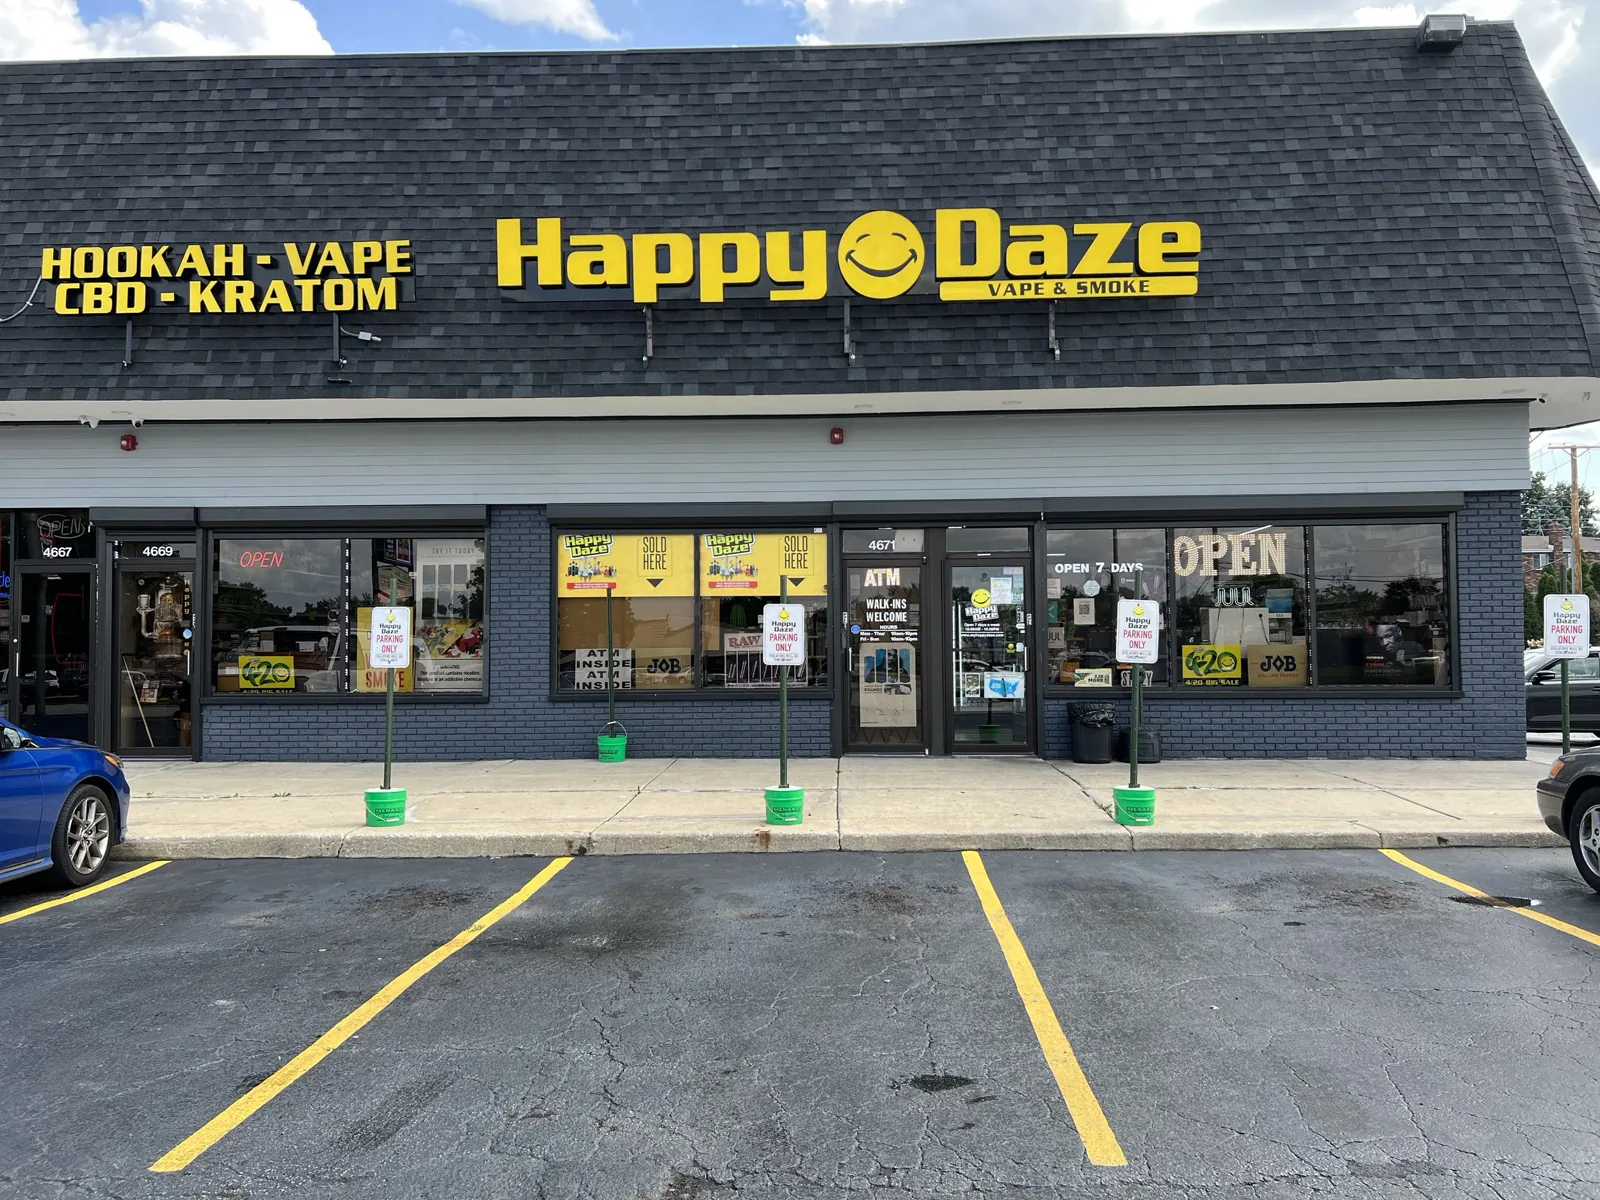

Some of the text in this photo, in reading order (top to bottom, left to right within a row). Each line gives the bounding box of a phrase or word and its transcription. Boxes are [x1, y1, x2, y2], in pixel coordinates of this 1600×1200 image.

[41, 243, 245, 280] HOOKAH
[284, 240, 411, 276] VAPE
[497, 208, 1201, 302] Happy Daze
[987, 279, 1150, 297] VAPE & SMOKE
[54, 281, 146, 315] CBD
[189, 277, 397, 314] KRATOM
[40, 518, 82, 538] OPEN
[565, 534, 612, 547] Happy
[643, 536, 667, 553] SOLD
[707, 533, 754, 546] Happy
[784, 535, 808, 552] SOLD
[868, 540, 895, 550] 4671
[43, 547, 72, 557] 4667
[142, 546, 173, 557] 4669
[572, 545, 608, 556] Daze
[714, 544, 749, 555] Daze
[1173, 533, 1287, 576] OPEN
[240, 551, 284, 568] OPEN
[643, 554, 667, 570] HERE
[784, 553, 808, 569] HERE
[1055, 562, 1144, 573] OPEN 7 DAYS
[864, 567, 901, 587] ATM
[1215, 587, 1254, 606] JUUL
[866, 598, 907, 609] WALK-INS
[965, 605, 997, 616] Happy
[866, 611, 908, 622] WELCOME
[973, 612, 999, 622] Daze
[1125, 617, 1151, 625] Happy
[1123, 630, 1153, 639] PARKING
[1551, 625, 1583, 634] PARKING
[376, 634, 404, 643] PARKING
[728, 635, 761, 648] RAW
[769, 633, 798, 642] PARKING
[1557, 635, 1576, 644] ONLY
[381, 644, 398, 653] ONLY
[775, 643, 792, 652] ONLY
[1129, 640, 1146, 649] ONLY
[576, 660, 630, 668] INSIDE
[647, 658, 681, 673] JOB
[1260, 655, 1297, 672] JOB
[576, 681, 630, 689] INSIDE
